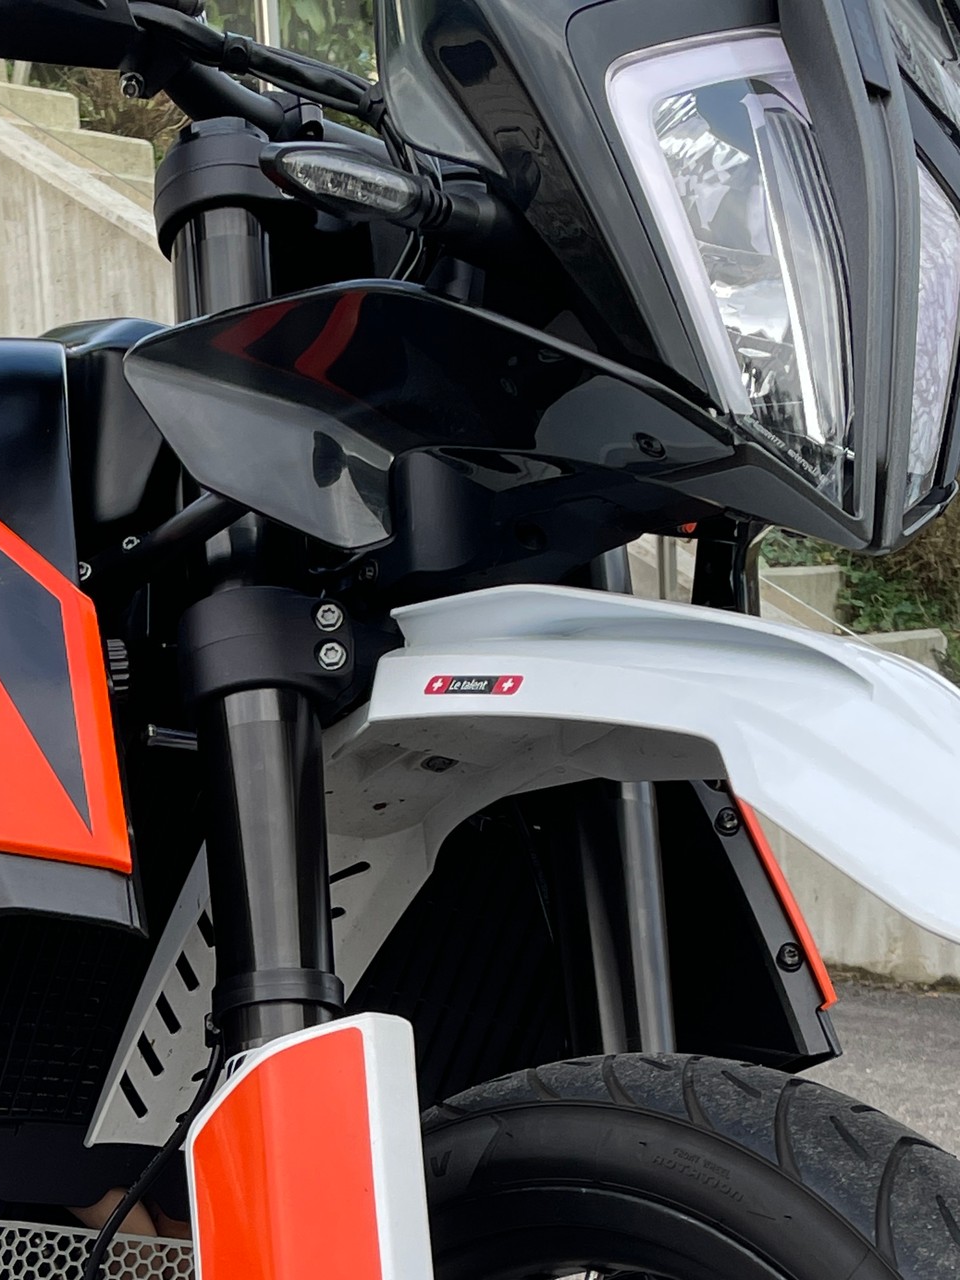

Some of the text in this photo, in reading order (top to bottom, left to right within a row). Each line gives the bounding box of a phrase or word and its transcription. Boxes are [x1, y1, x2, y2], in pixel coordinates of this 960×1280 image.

[449, 679, 489, 690] Le talent
[652, 1154, 745, 1203] ROTATION
